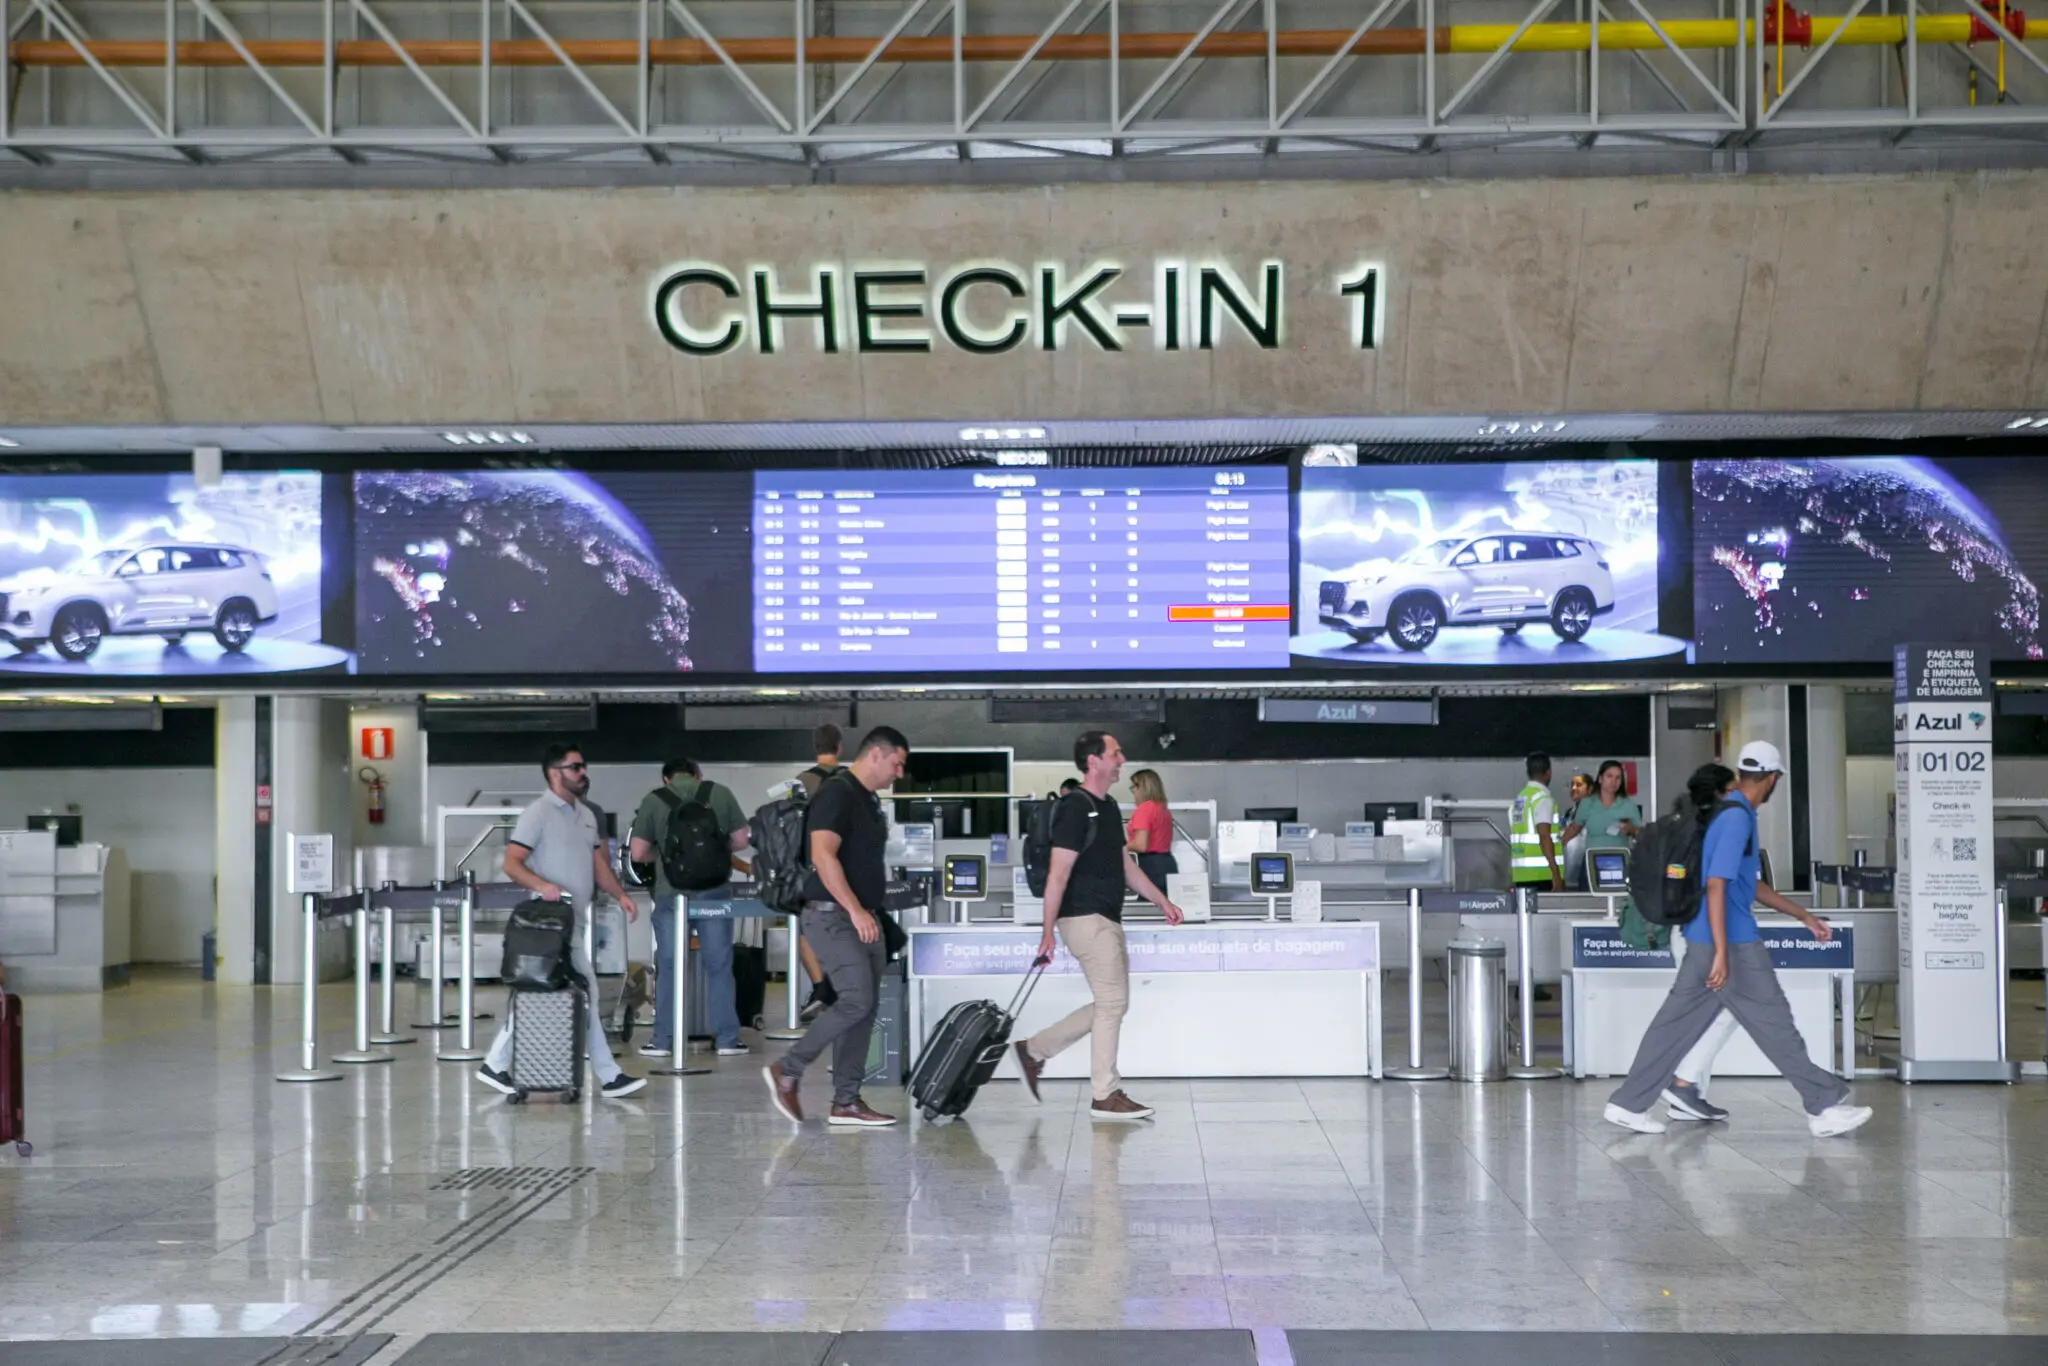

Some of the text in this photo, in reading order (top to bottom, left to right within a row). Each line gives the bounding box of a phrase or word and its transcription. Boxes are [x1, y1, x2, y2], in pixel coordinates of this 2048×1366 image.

[655, 265, 1376, 355] CHECK-IN 1
[1926, 649, 1975, 660] FAÇA SEU
[1926, 659, 1975, 668] CHECK-IN
[1923, 668, 1976, 678] E IMPRIMA
[1921, 678, 1980, 687] A ETIQUETA
[1916, 687, 1983, 696] DE BAGAGEM
[1316, 703, 1357, 720] Azul
[1915, 713, 1962, 730] Azul
[1923, 752, 1985, 772] 01 02
[1932, 802, 1971, 810] Check-in
[1425, 823, 1442, 837] 20
[1933, 902, 1974, 912] Print your
[1159, 943, 1185, 953] sua
[1188, 941, 1247, 955] etiqueta
[1252, 939, 1271, 953] de
[1275, 938, 1345, 955] bagagem
[1583, 938, 1607, 949] Faça
[1781, 939, 1794, 949] de
[1796, 939, 1842, 950] bagagem
[943, 943, 980, 959] Faça
[984, 945, 1007, 956] seu
